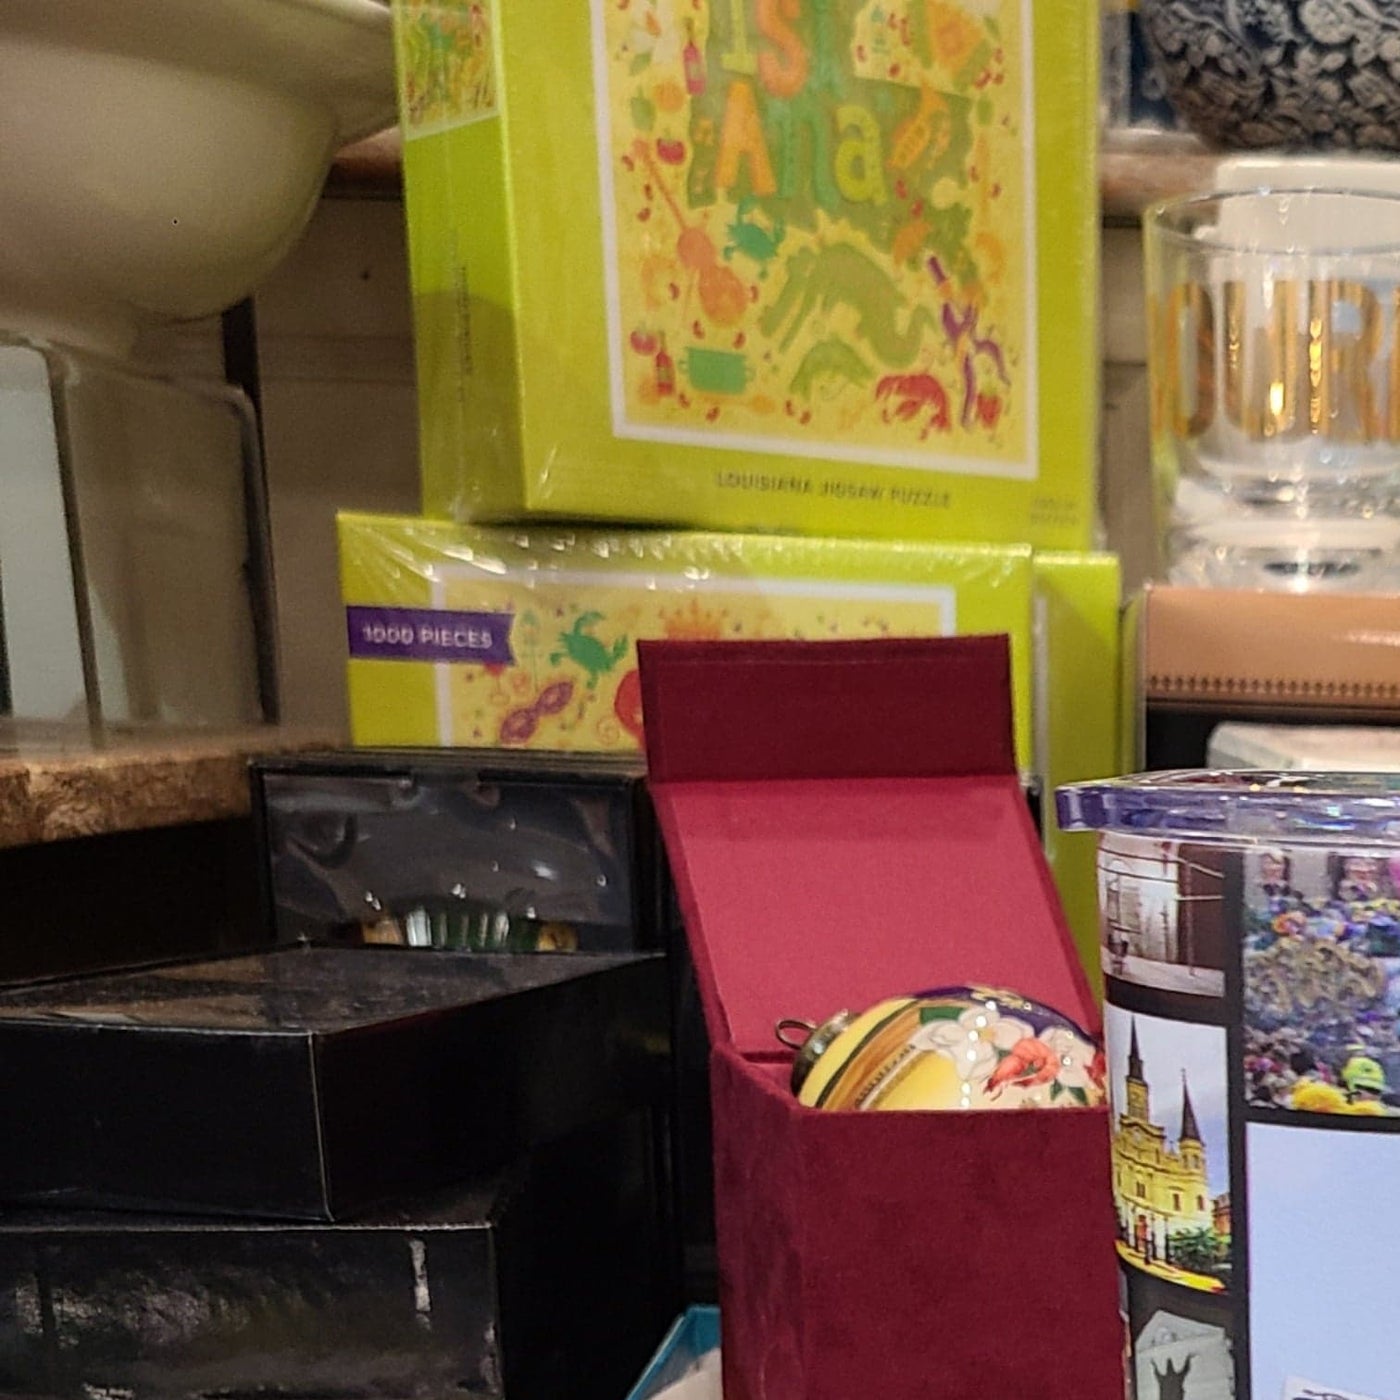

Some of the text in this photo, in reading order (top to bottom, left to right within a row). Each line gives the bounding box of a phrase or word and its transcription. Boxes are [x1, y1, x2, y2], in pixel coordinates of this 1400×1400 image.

[716, 471, 951, 508] LOUISIANA JIGSAW PUZZLE
[362, 622, 493, 649] 1000 PIECES
